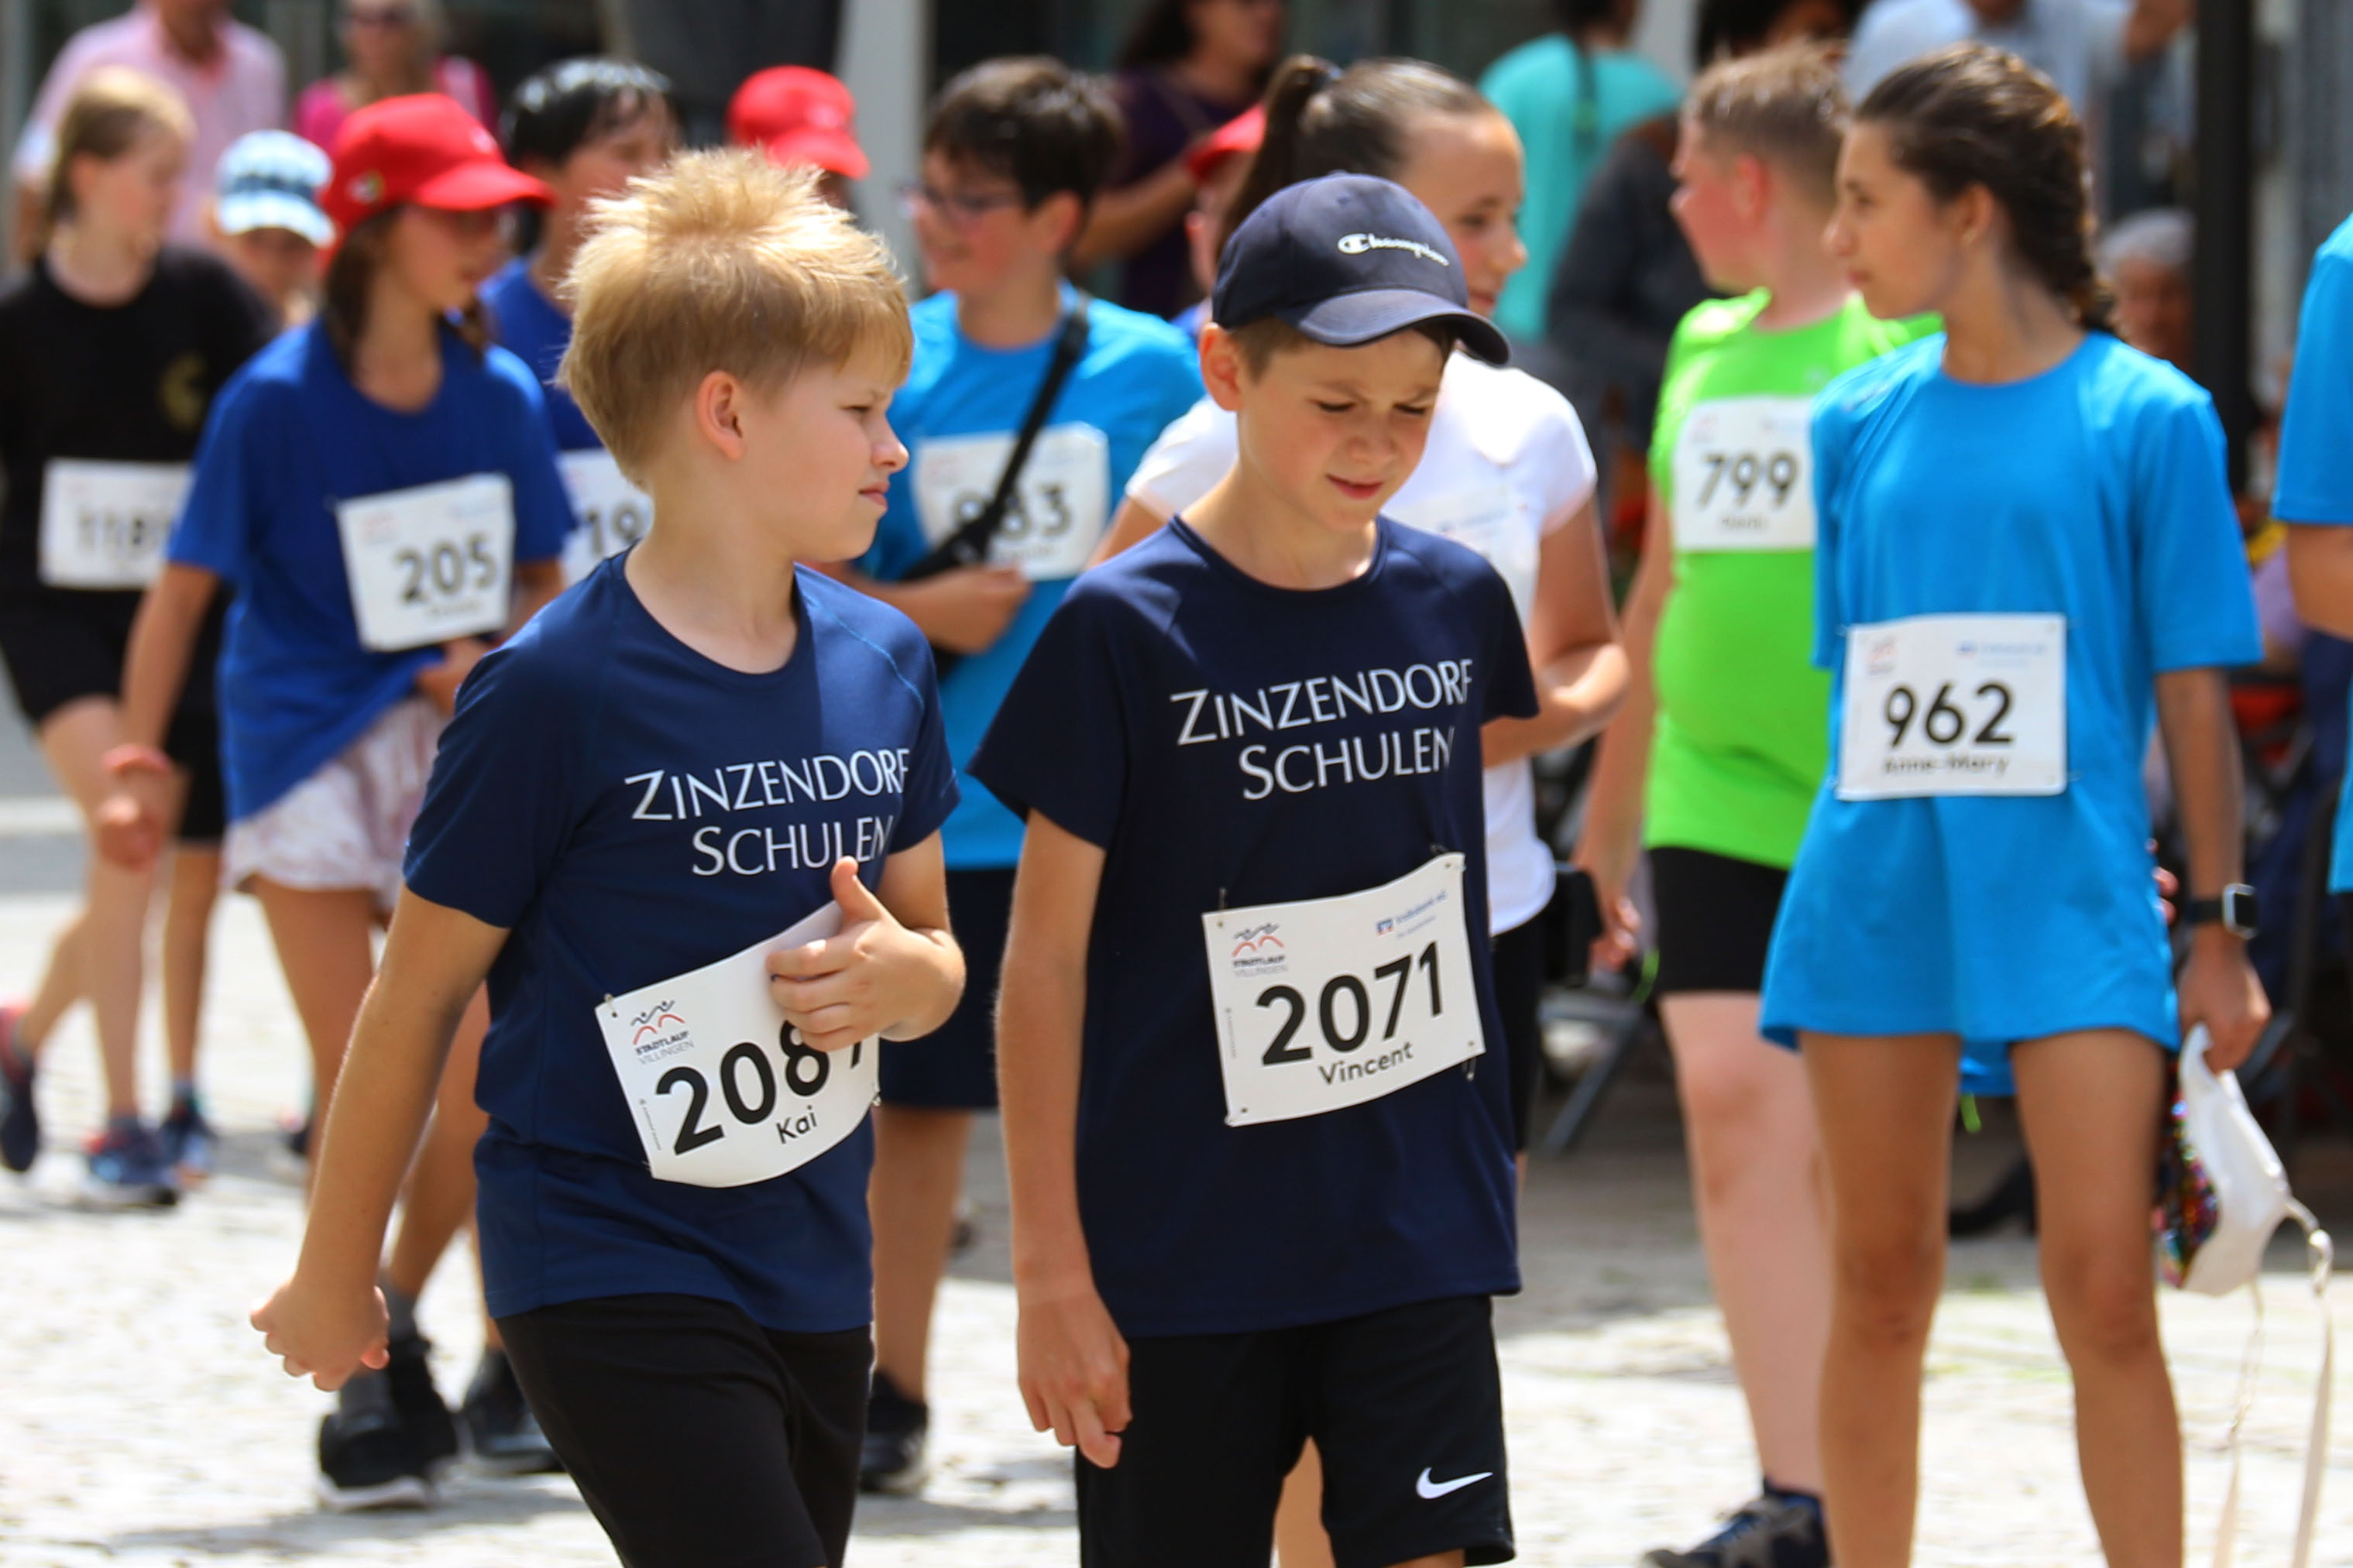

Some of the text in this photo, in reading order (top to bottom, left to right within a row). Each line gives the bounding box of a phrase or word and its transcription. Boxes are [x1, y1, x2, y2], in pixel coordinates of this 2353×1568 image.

[1338, 233, 1450, 266] Champion
[1698, 451, 1799, 509] 799
[393, 533, 496, 604] 205
[1170, 659, 1472, 746] ZINZENDORF
[1884, 678, 2016, 750] 962
[624, 749, 910, 821] ZINZENDORF
[1239, 726, 1455, 801] SCHULEN
[692, 815, 894, 876] SCHULEN
[1256, 941, 1442, 1066] 2071
[635, 1031, 689, 1055] STADTLAUF
[1319, 1041, 1414, 1085] Vincent
[777, 1105, 817, 1144] Kai
